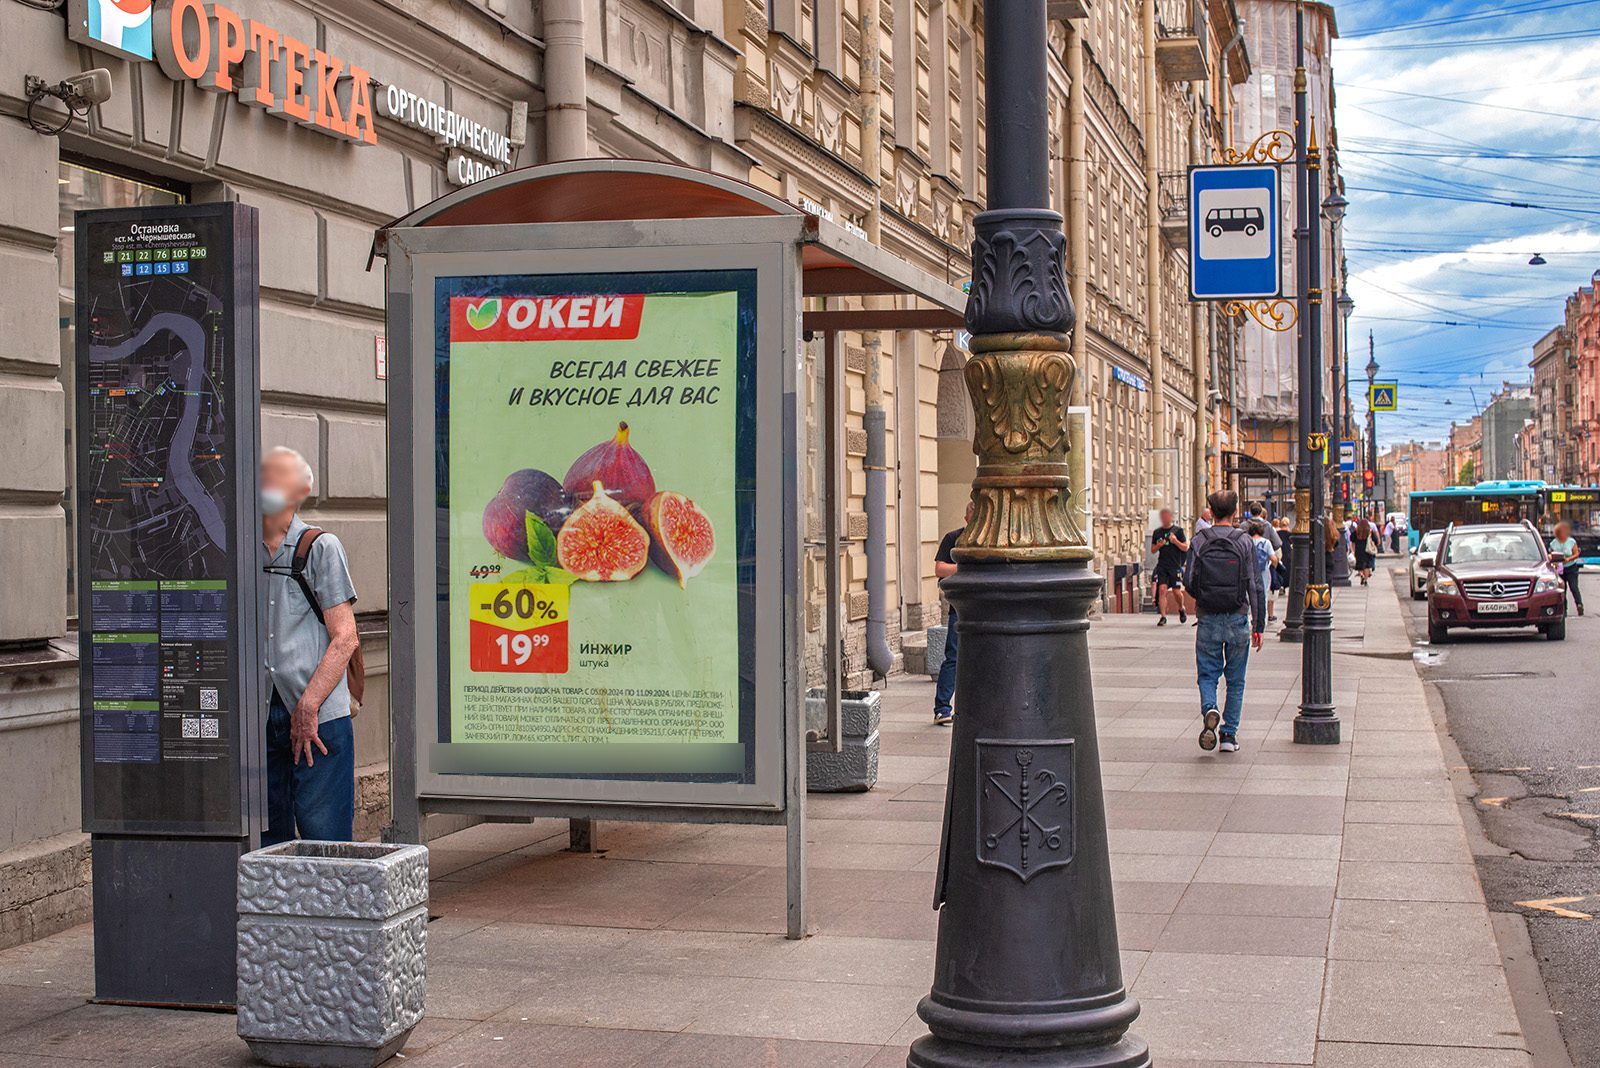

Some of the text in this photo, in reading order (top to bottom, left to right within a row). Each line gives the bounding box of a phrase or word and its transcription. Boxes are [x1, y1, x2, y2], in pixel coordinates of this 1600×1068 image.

[171, 0, 377, 146] ОРТЕКА
[387, 84, 511, 164] ОРТОПЕДИЧЕСКИЕ
[131, 224, 180, 234] Остановка
[136, 233, 196, 243] «Чернышевская»
[173, 250, 187, 258] 105
[191, 249, 206, 257] 290
[176, 264, 185, 272] 33
[550, 358, 722, 381] ВСЕГДА СВЕЖЕЕ
[508, 386, 720, 408] И ВКУСНОЕ ДЛЯ ВАС
[480, 588, 558, 620] -60%
[580, 643, 632, 656] ИНЖИР
[579, 659, 609, 668] штука
[464, 686, 489, 694] ПЕРИОД
[490, 685, 523, 694] ДЕЙСТВИЯ
[709, 720, 725, 729] ООО
